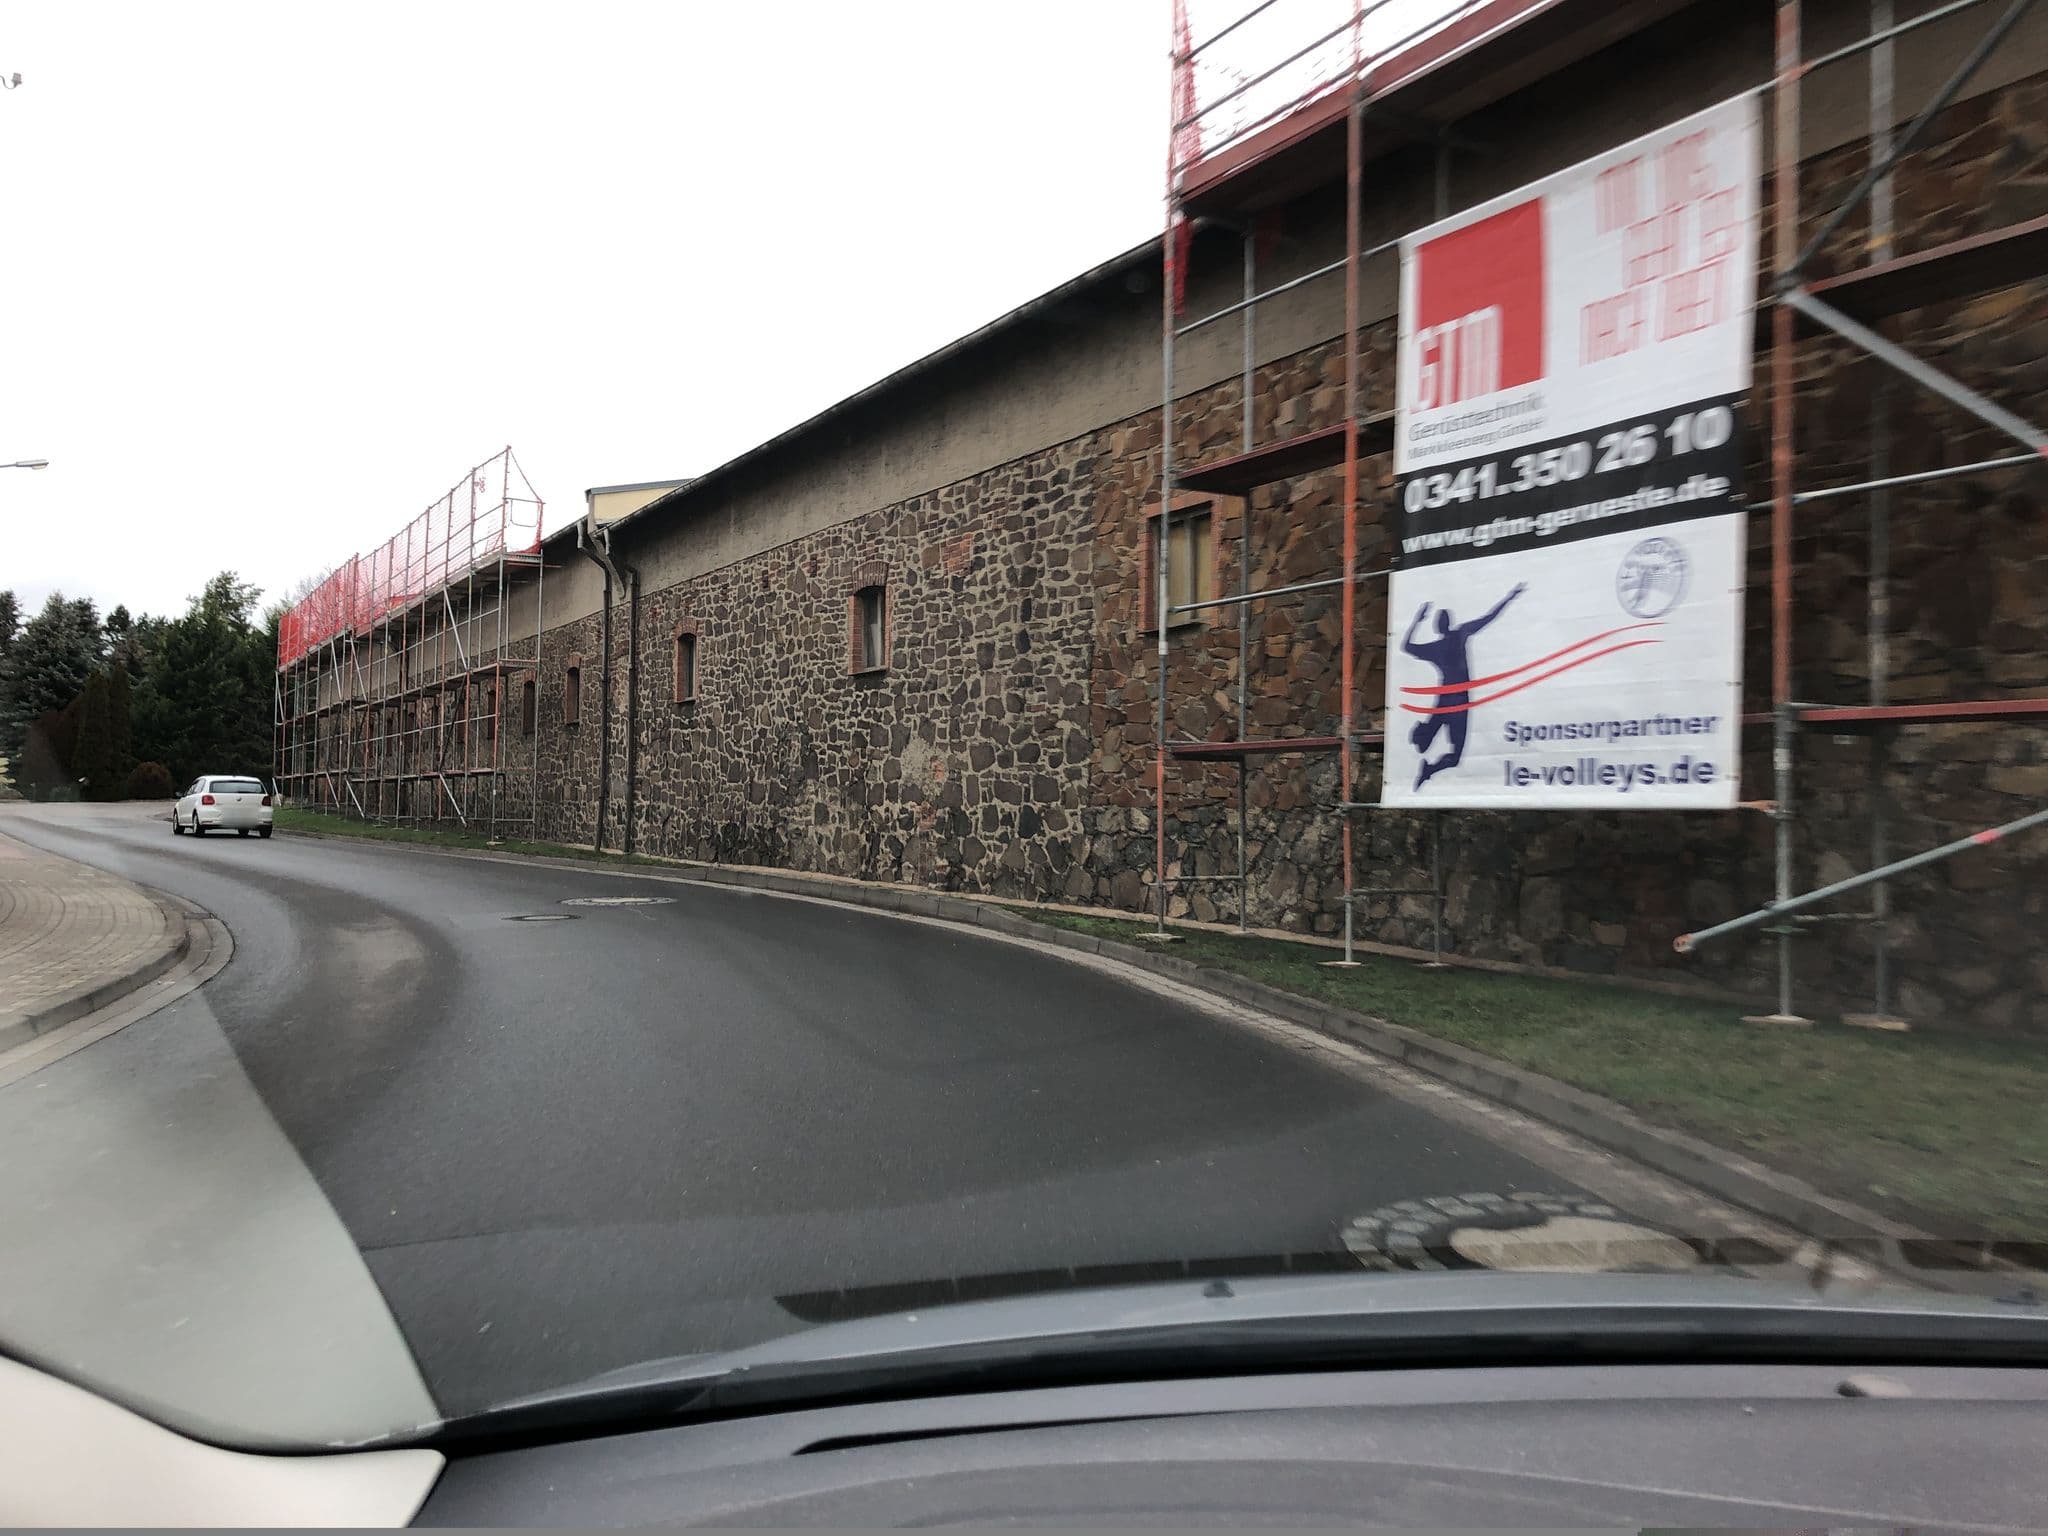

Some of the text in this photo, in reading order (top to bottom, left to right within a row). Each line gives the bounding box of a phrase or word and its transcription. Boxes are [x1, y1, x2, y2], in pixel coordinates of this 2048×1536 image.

[1594, 423, 1659, 474] 26
[1664, 405, 1735, 456] 10
[1503, 713, 1721, 746] Sponsorpartner
[1503, 755, 1716, 793] le-volleys.de
